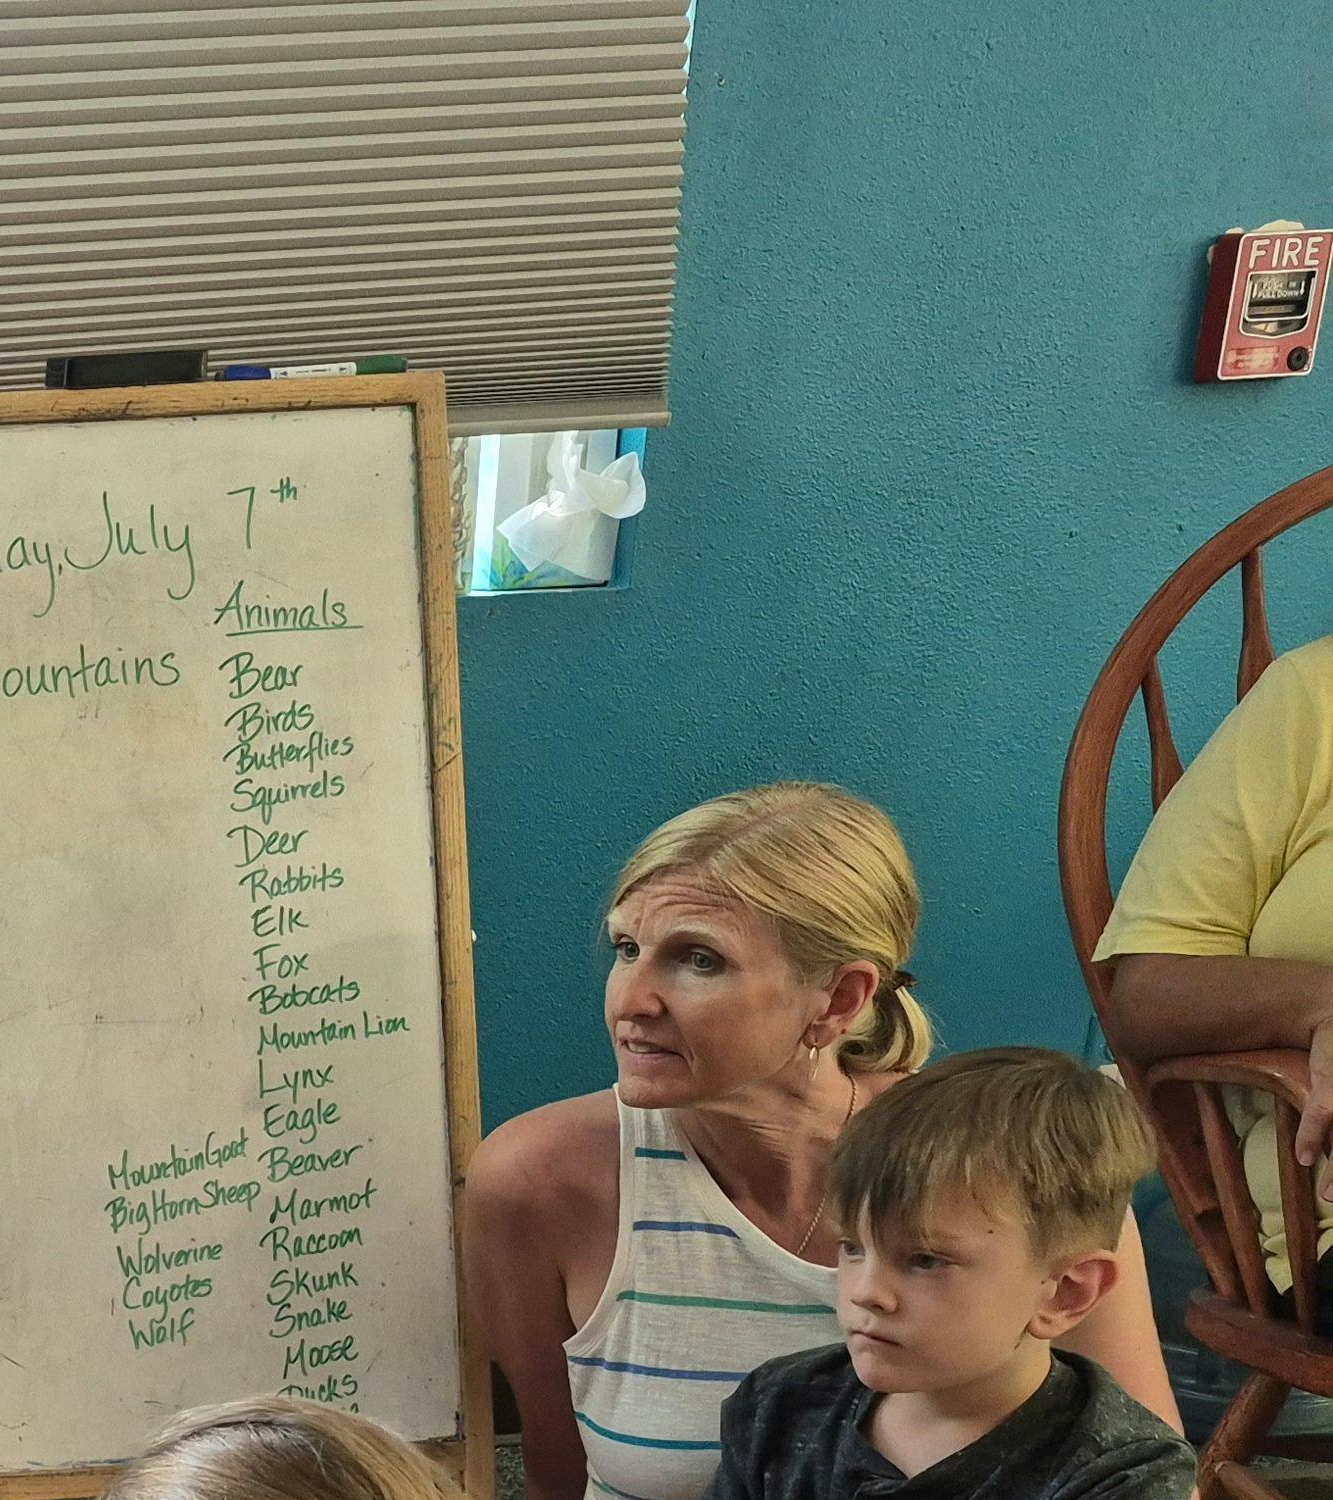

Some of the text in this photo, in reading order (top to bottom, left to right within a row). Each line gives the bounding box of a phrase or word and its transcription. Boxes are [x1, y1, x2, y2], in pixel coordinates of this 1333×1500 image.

[1248, 236, 1323, 269] FIRE
[64, 491, 196, 600] July
[214, 581, 347, 628] Animals
[219, 652, 303, 698] Bear
[225, 701, 314, 742] Birds
[222, 733, 354, 774] Butterflies
[231, 771, 345, 822] Squirrels
[227, 826, 307, 871] Deer
[239, 863, 344, 902] Rabbits
[251, 905, 309, 937] Elk
[253, 944, 309, 980] Fox
[248, 975, 360, 1015] Bobcats
[257, 1011, 410, 1055] Mountain Lion
[259, 1059, 334, 1104] Lynx
[264, 1098, 340, 1144] Eagle
[258, 1146, 363, 1182] Beaver
[269, 1178, 377, 1225] Marmot
[116, 1237, 223, 1278] Wolverine
[259, 1225, 362, 1261] Raccoon
[122, 1275, 213, 1323] Coyotes
[267, 1261, 358, 1306] Skunk
[129, 1307, 195, 1350] Wolf
[269, 1299, 352, 1338] Snake
[283, 1335, 358, 1379] Moose
